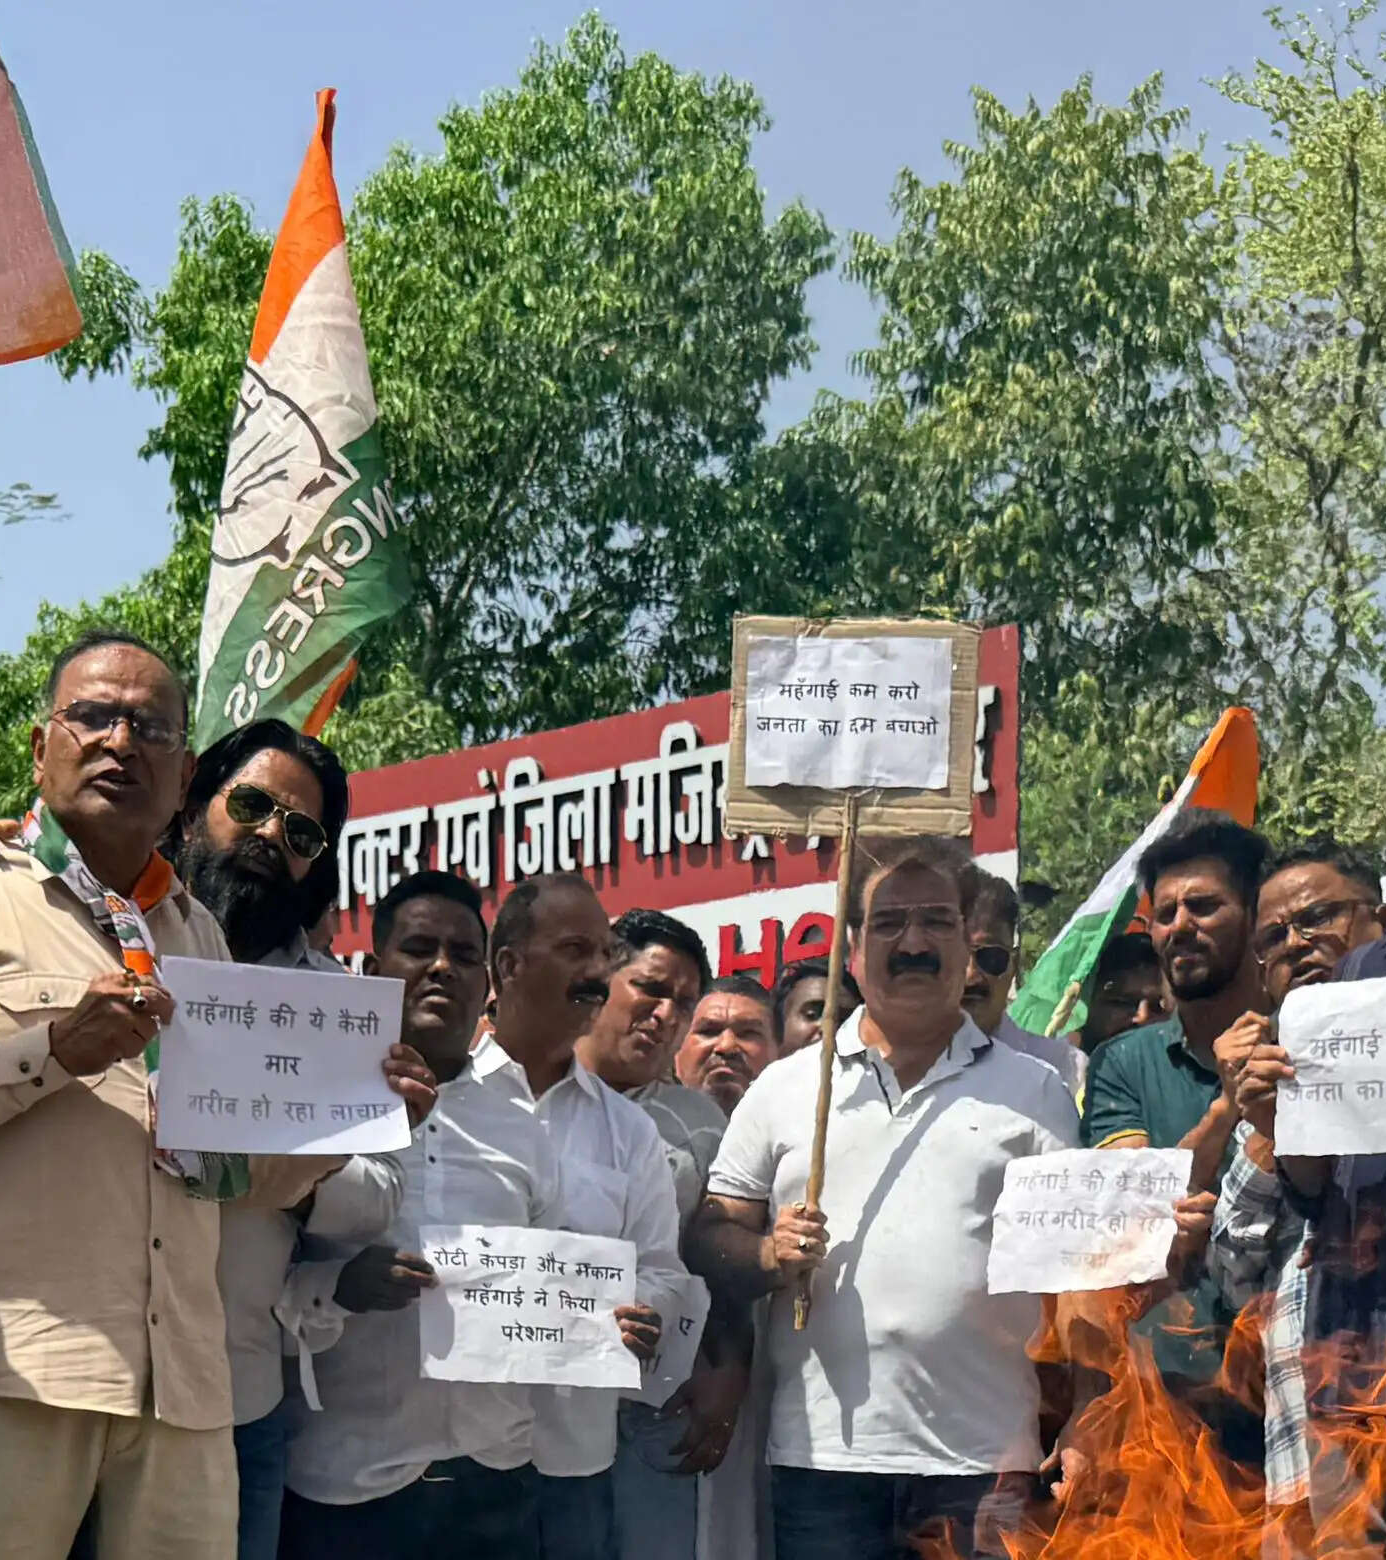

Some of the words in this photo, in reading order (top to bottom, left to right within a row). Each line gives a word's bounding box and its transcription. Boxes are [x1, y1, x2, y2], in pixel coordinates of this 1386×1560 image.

[778, 677, 840, 702] महँगाई
[849, 682, 878, 699] कम
[887, 681, 921, 700] करो
[757, 716, 808, 733] जनता
[817, 718, 841, 736] का
[849, 717, 877, 735] दम
[885, 716, 940, 736] बचाओ
[499, 756, 616, 883] जिला
[186, 994, 258, 1030] महँगाई
[269, 1003, 297, 1029] की
[309, 1007, 327, 1031] ये
[338, 1008, 380, 1036] कैसी
[265, 1054, 301, 1076] मार
[1285, 1082, 1344, 1103] जनता
[1356, 1081, 1384, 1101] का
[251, 1094, 272, 1121] हो
[284, 1102, 316, 1122] रहा
[329, 1102, 392, 1121] लाचार
[433, 1247, 469, 1267] रोटी
[537, 1251, 567, 1275] और
[575, 1263, 624, 1281] मकान
[464, 1283, 525, 1307] महँगाई
[534, 1288, 550, 1307] ने
[559, 1290, 597, 1313] किया
